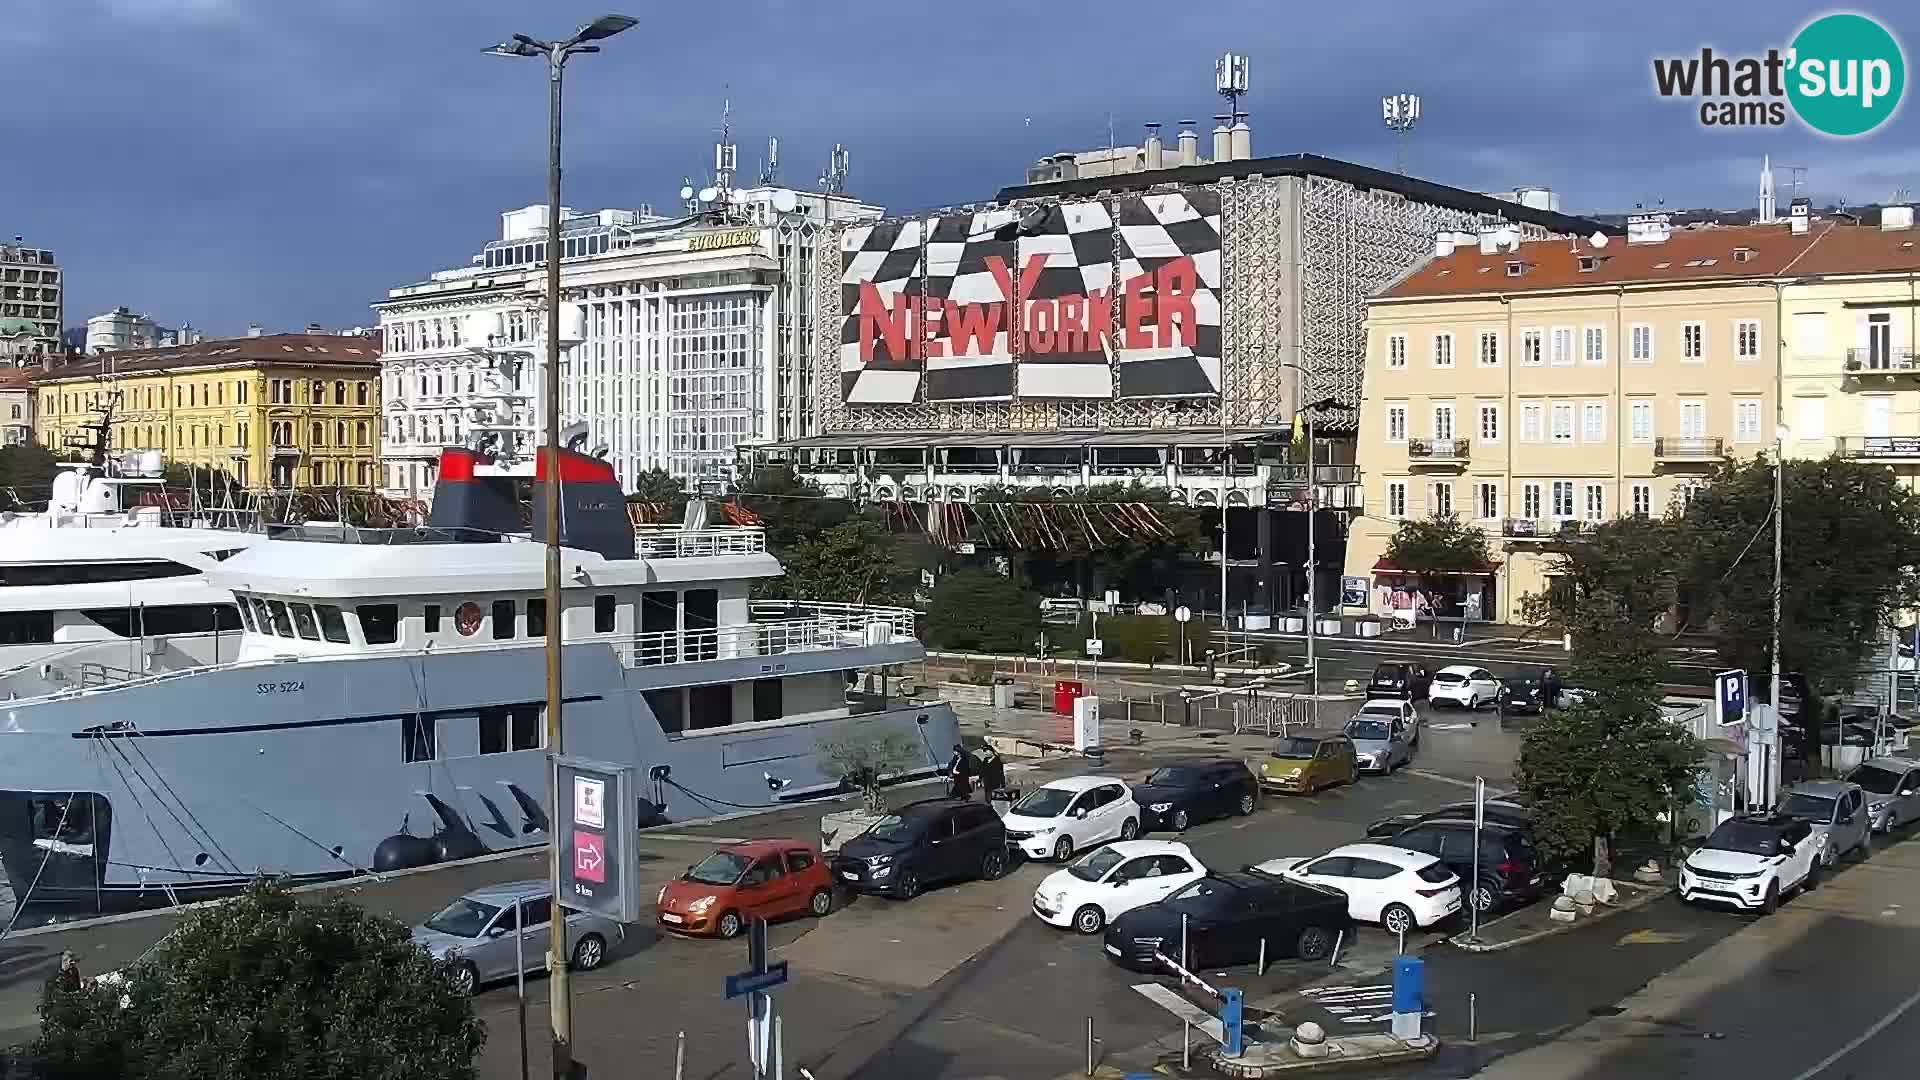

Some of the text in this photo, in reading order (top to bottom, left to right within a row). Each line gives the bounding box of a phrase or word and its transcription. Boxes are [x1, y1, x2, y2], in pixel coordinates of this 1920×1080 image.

[859, 253, 1198, 362] NEW YORKER
[257, 681, 305, 694] SSR 5224
[575, 883, 593, 897] 5 km
